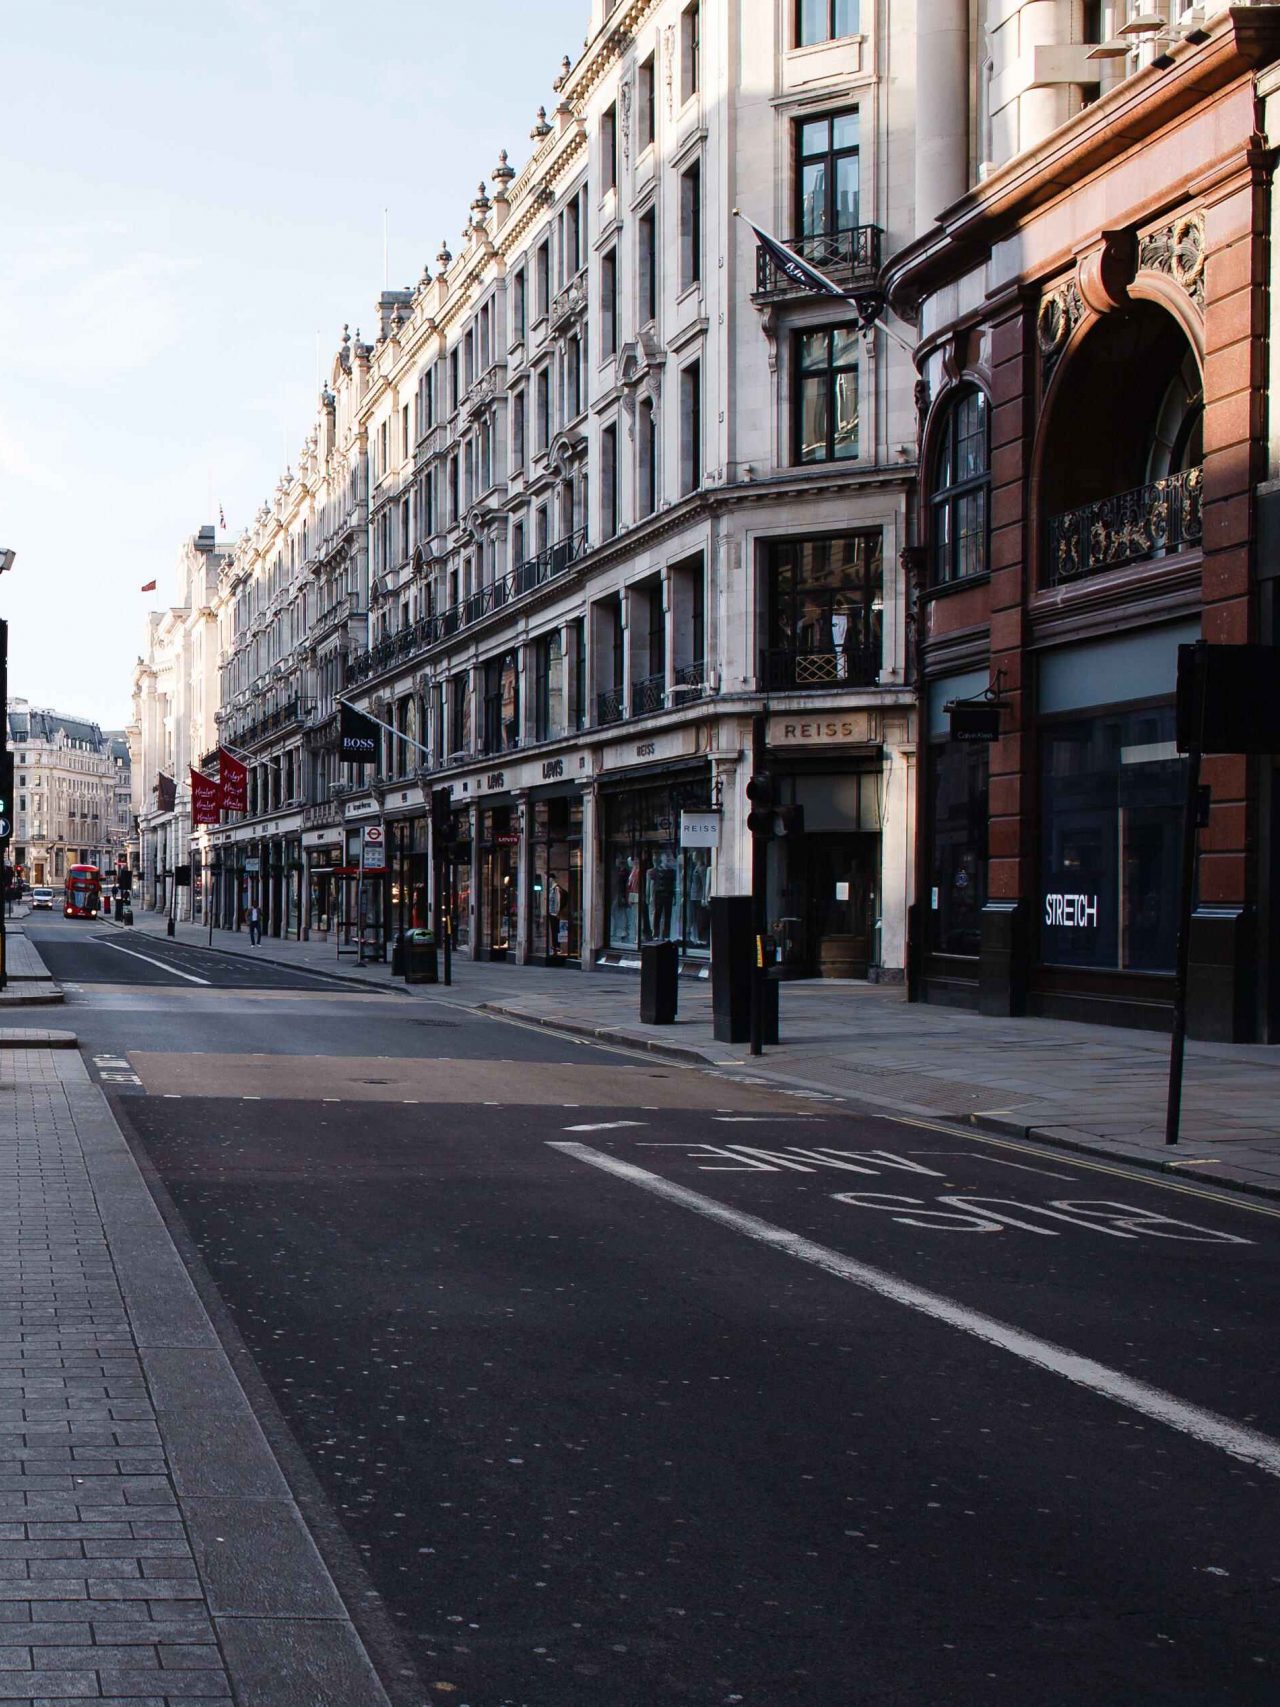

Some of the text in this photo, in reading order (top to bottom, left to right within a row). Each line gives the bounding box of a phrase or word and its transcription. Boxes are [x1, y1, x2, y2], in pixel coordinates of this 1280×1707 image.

[343, 737, 374, 748] BOSS
[784, 722, 853, 738] REISS
[636, 742, 655, 757] REISS
[1045, 893, 1097, 927] STRETCH
[635, 1142, 1078, 1181] LANE
[828, 1191, 1261, 1245] BUS
